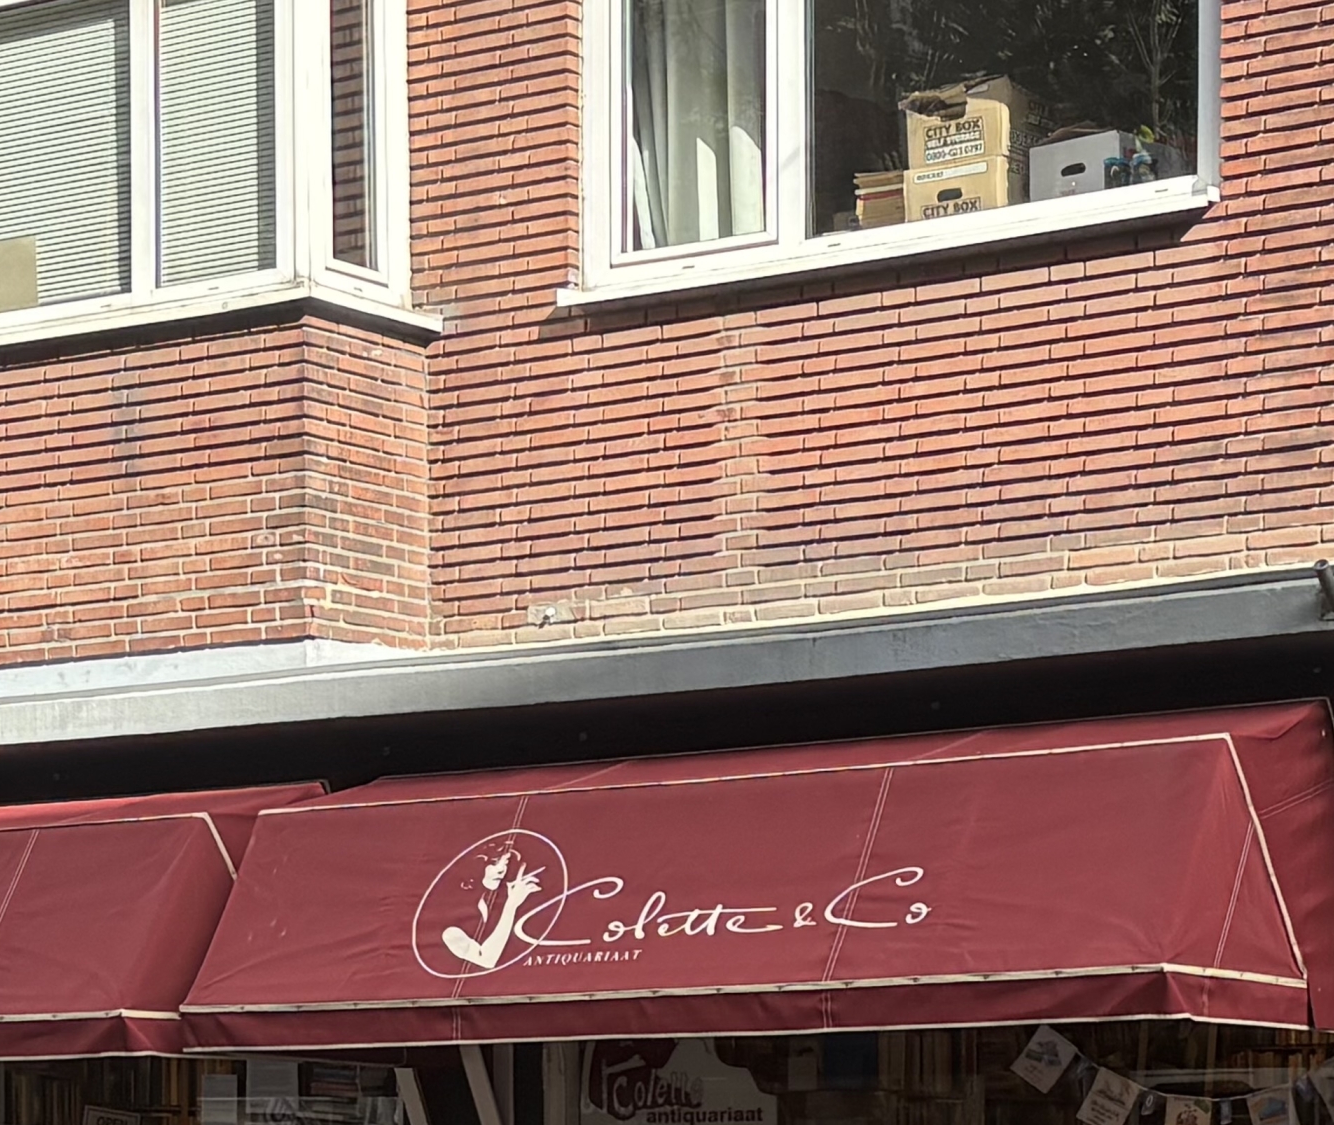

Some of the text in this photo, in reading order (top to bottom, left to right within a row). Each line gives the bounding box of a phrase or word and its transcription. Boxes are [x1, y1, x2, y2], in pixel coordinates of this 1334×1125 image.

[925, 118, 982, 139] CITY BOX
[923, 199, 979, 219] CITY BOX
[514, 866, 932, 946] Colette & Co
[523, 948, 643, 968] ANTIQUARIAAT
